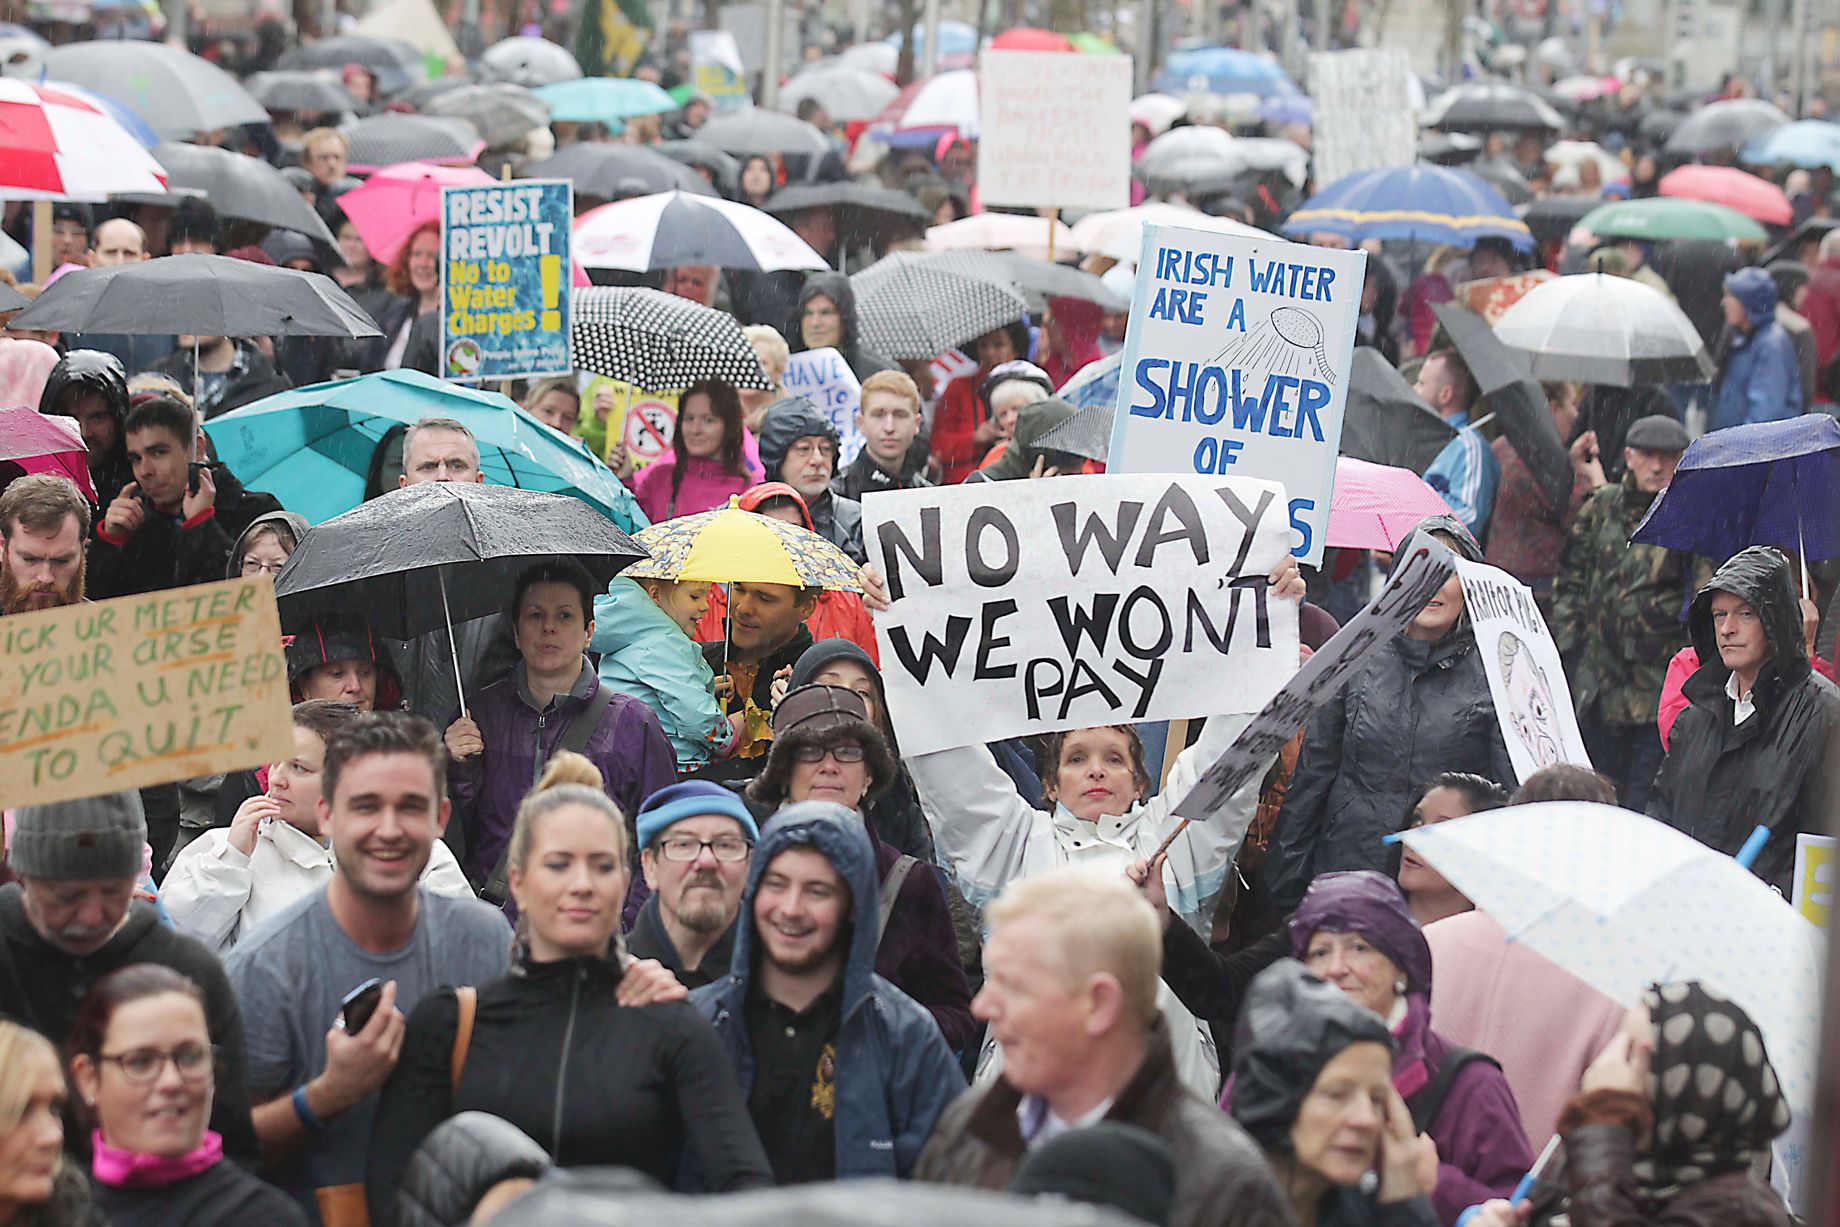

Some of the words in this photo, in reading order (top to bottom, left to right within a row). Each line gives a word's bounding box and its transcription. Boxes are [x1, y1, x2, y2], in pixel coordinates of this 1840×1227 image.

[450, 188, 543, 226] RESIST
[450, 222, 554, 260] REVOLT
[449, 260, 480, 285] No
[487, 259, 511, 283] to
[1155, 247, 1234, 288] IRISH
[1248, 258, 1336, 301] WATER
[449, 285, 516, 310] Water
[1149, 287, 1208, 326] ARE
[1226, 298, 1246, 332] A
[449, 310, 537, 335] Charges
[783, 357, 843, 387] HAVE
[823, 385, 848, 407] TO
[1129, 358, 1332, 442] SHOWER
[1193, 437, 1245, 475] OF
[877, 505, 1020, 602] NO
[1050, 482, 1275, 579] WAY
[2, 620, 58, 654] iCK
[75, 606, 118, 642] UR
[134, 585, 256, 631] METER
[887, 598, 1019, 686] WE
[1047, 574, 1274, 663] WON'T
[19, 642, 115, 695] YOUR
[1024, 657, 1165, 720] PAY
[0, 688, 119, 742] ENDA
[137, 676, 170, 707] U
[187, 652, 282, 700] NEED
[26, 748, 78, 788] TO
